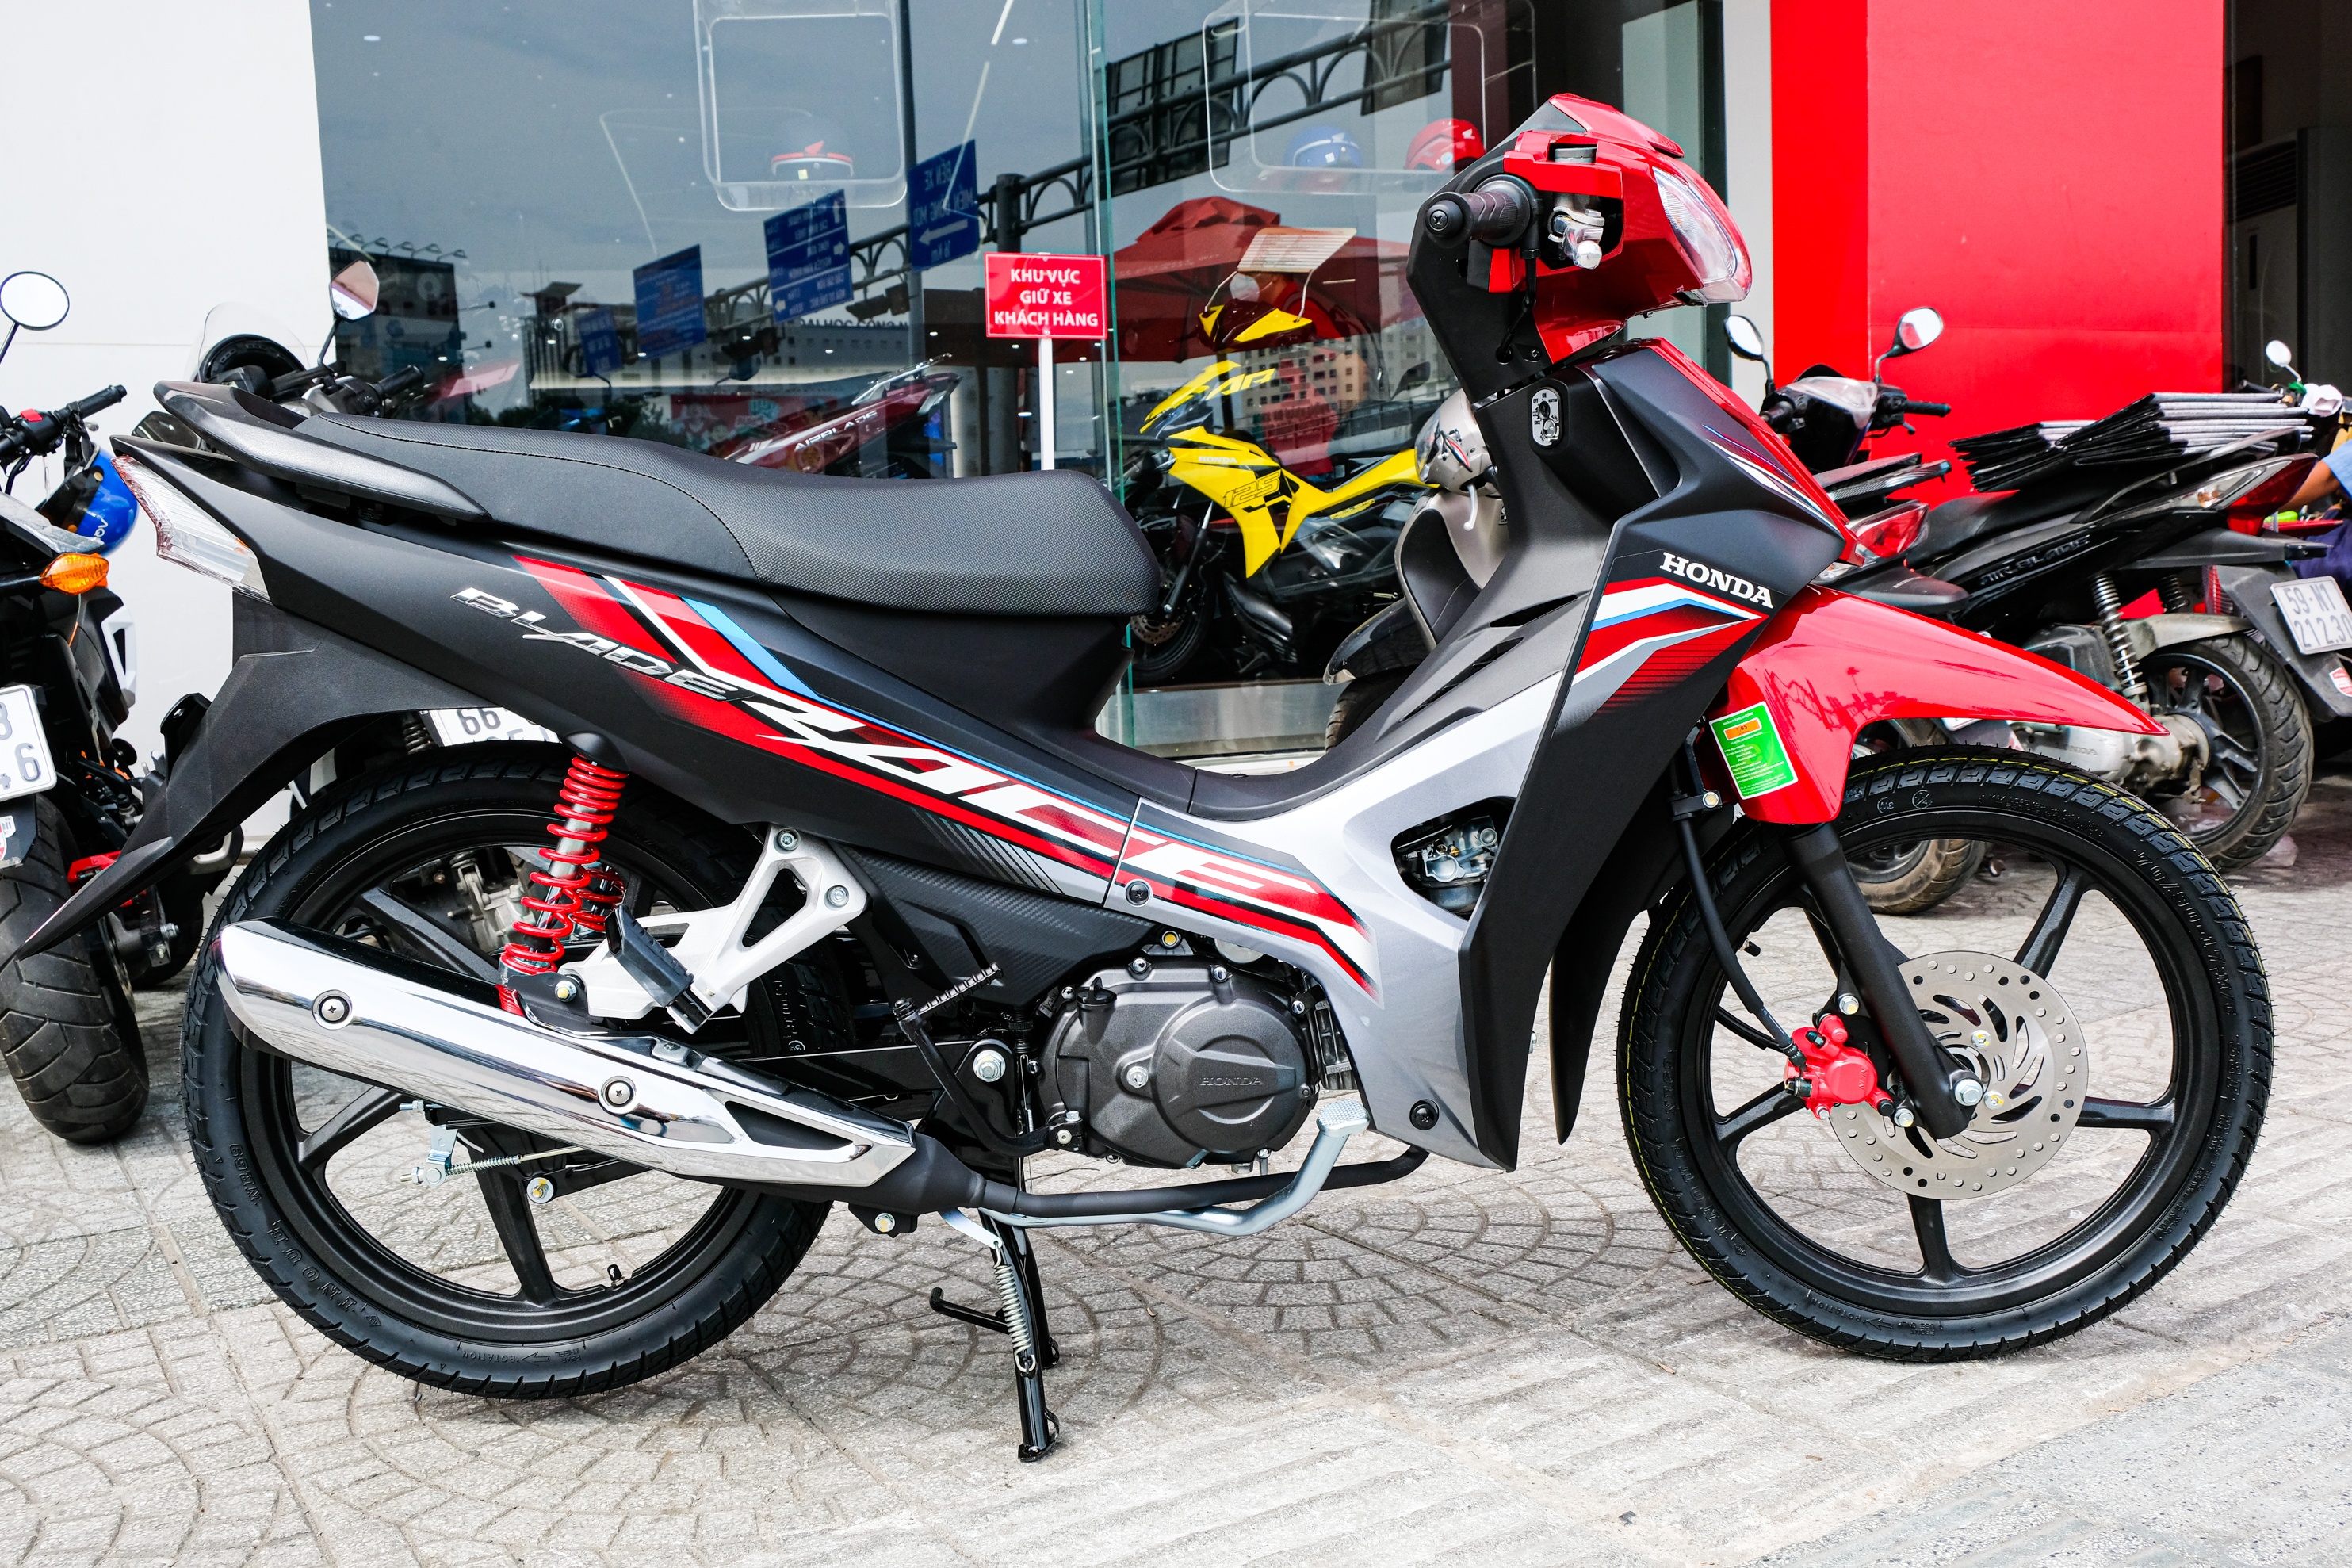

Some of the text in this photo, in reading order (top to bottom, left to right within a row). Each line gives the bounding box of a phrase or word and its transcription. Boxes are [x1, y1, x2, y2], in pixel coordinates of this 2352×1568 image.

[1011, 268, 1080, 287] KHU VỰC
[1019, 288, 1072, 304] GIỮ XE
[994, 310, 1098, 327] KHÁCH HÀNG
[1222, 471, 1280, 509] 125
[1660, 551, 1774, 609] HONDA
[2282, 583, 2336, 614] 59-N1
[449, 587, 739, 702] BLADE
[1200, 1077, 1265, 1086] HONDA
[228, 1142, 263, 1203] NR69
[266, 1226, 358, 1314] INOUE
[461, 1349, 518, 1363] ROTATION
[554, 1348, 580, 1358] WHEEL
